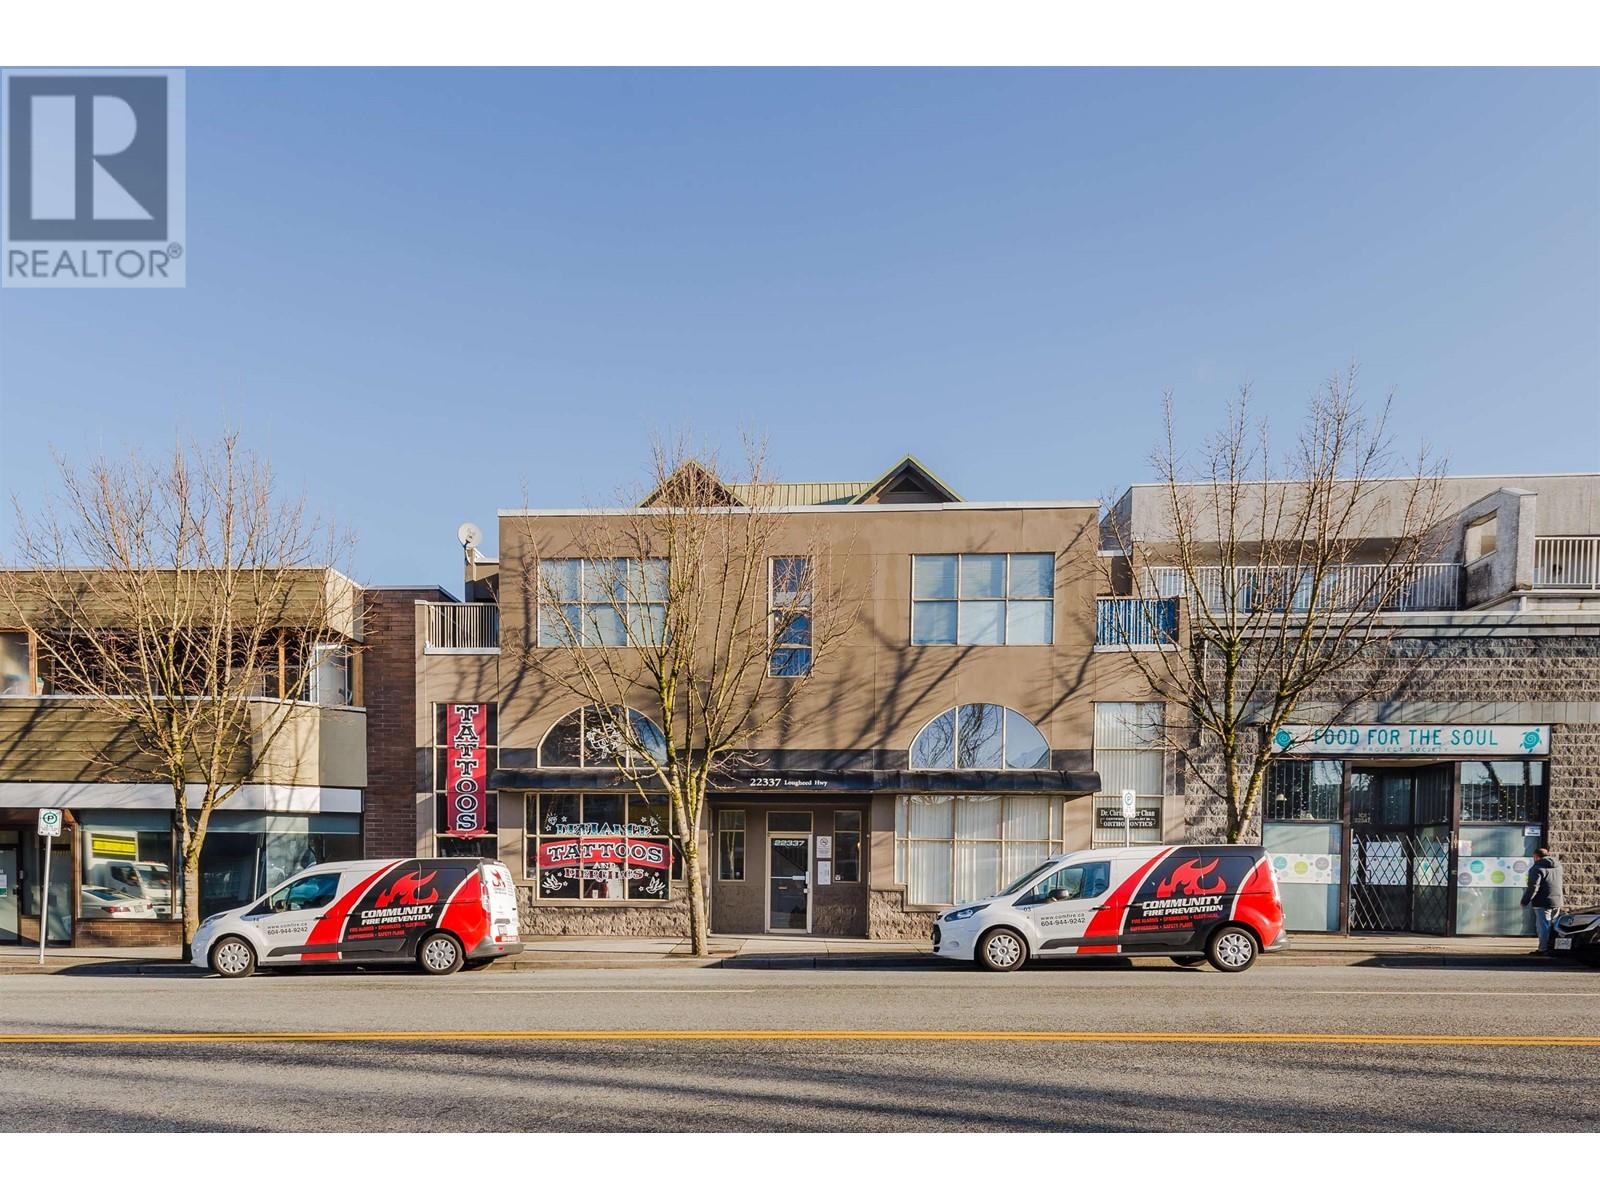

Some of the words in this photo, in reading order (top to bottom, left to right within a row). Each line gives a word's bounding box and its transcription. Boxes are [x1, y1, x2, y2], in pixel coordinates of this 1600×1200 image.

[1314, 729, 1360, 745] FOOD
[1367, 729, 1400, 745] FOR
[1408, 729, 1442, 745] THE
[1451, 729, 1498, 745] SOUL
[454, 704, 480, 831] TATTOOS
[750, 778, 781, 787] 22337
[784, 780, 812, 788] Lougheed
[814, 780, 828, 788] Hwy
[774, 839, 805, 848] 22337
[547, 842, 663, 863] TATTOOS
[1142, 895, 1222, 909] COMMUNITY
[361, 905, 433, 919] COMMUNITY
[1143, 908, 1164, 917] FIRE
[1165, 904, 1224, 915] PREVENTION
[361, 917, 381, 925] FIRE
[381, 913, 434, 923] PREVENTION
[1040, 918, 1086, 927] 604-944-9242
[267, 927, 308, 935] 604-944-9242
